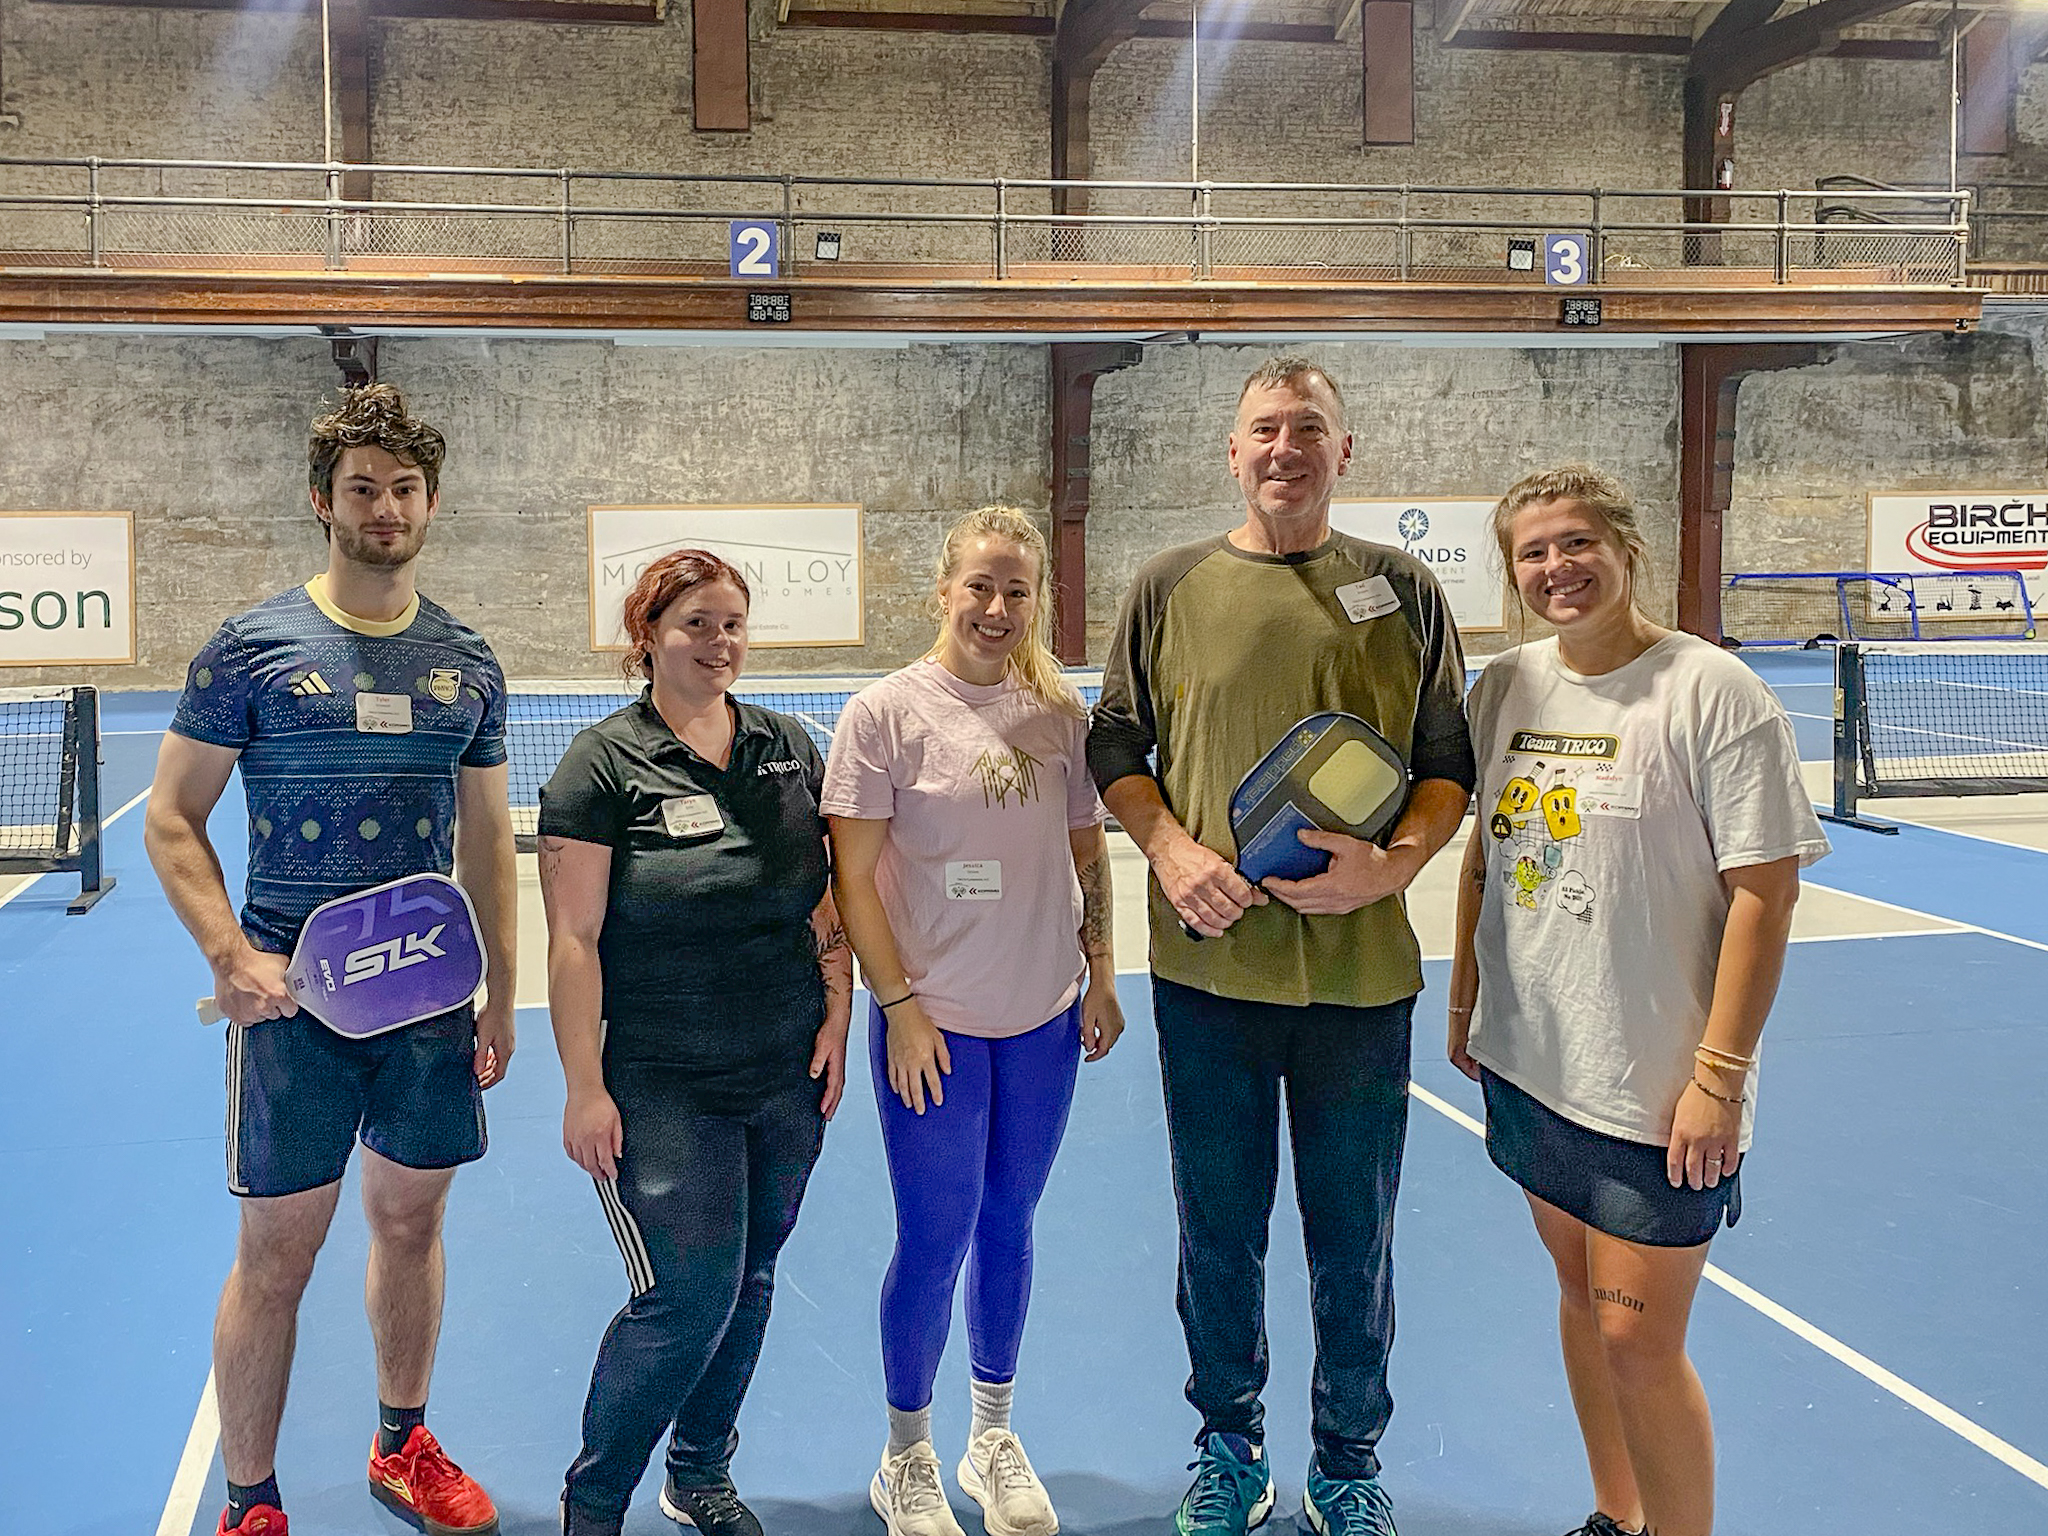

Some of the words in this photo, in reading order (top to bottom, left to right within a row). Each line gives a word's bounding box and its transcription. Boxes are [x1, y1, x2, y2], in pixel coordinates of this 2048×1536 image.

[736, 227, 772, 275] 2
[1550, 239, 1582, 284] 3
[1929, 530, 2048, 545] EQUIPMENT
[0, 549, 65, 566] nsored
[71, 549, 92, 570] by
[787, 559, 852, 583] LOY
[761, 587, 852, 598] HOMES
[1518, 734, 1558, 752] Team
[1561, 738, 1607, 755] TRICO
[763, 760, 801, 774] TRICO
[342, 922, 448, 986] SLK
[319, 959, 337, 992] EVO
